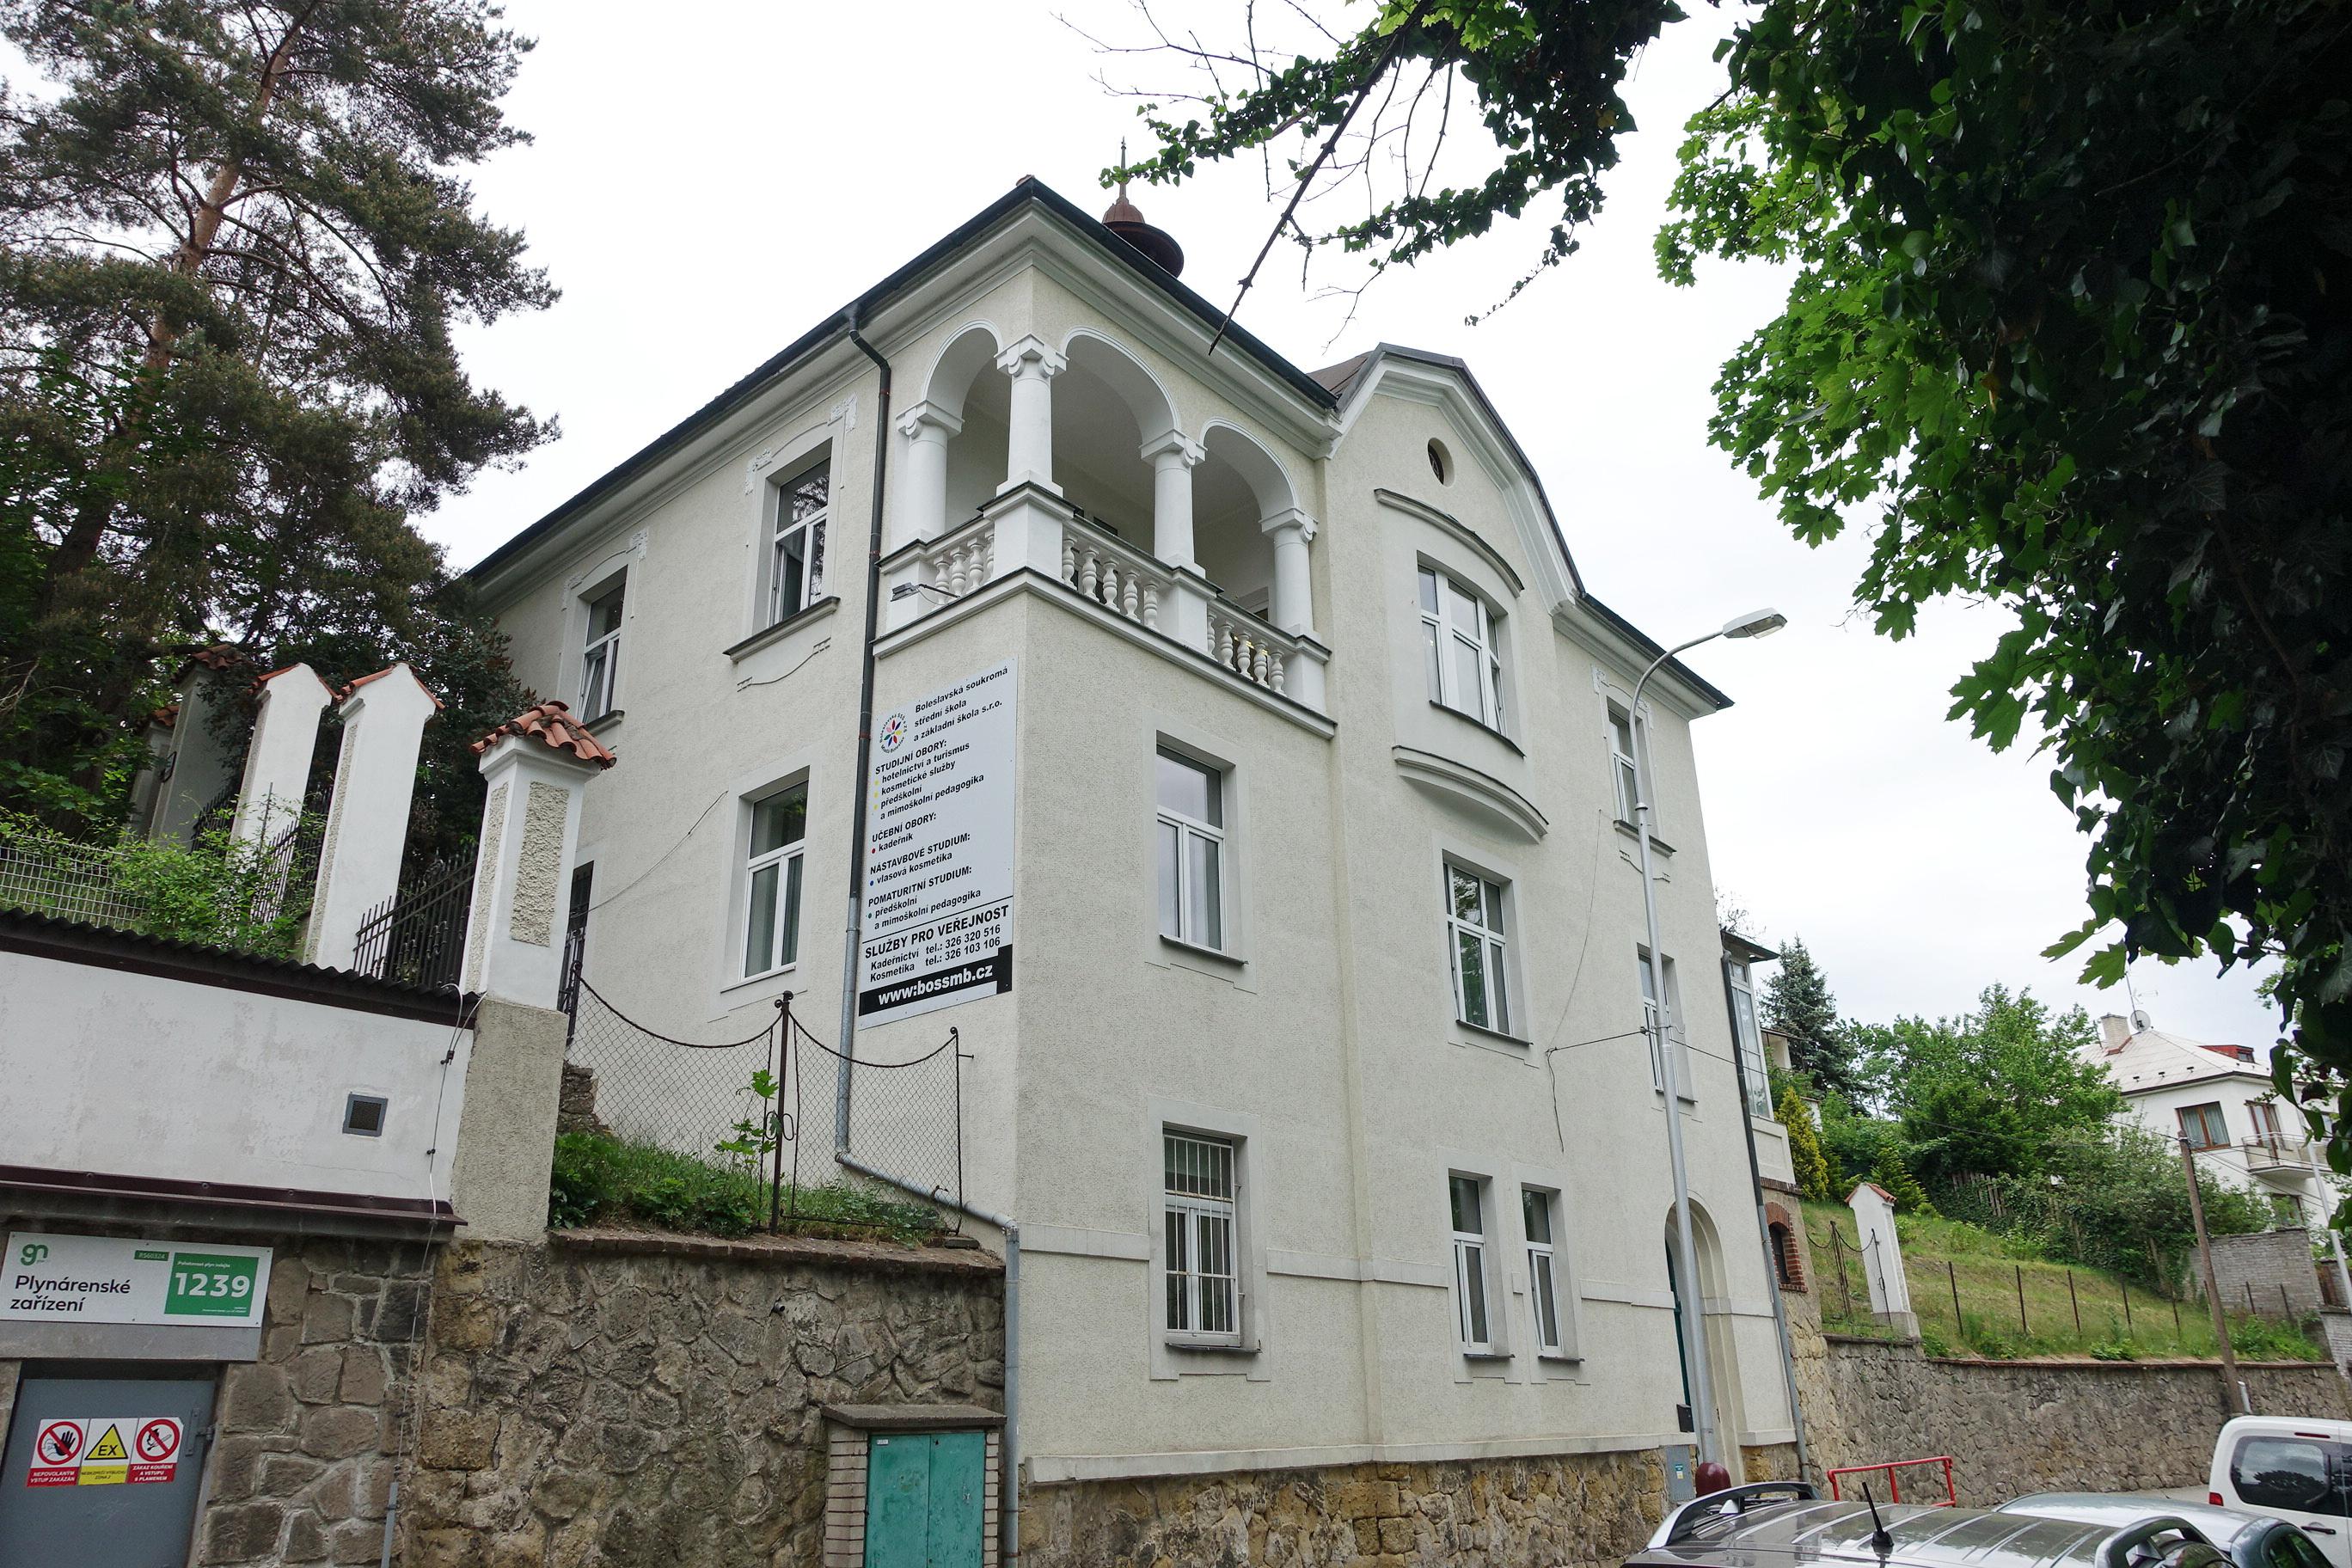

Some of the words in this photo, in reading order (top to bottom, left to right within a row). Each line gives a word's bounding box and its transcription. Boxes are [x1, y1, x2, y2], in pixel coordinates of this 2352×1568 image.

[916, 686, 964, 714] Boleslavská
[965, 666, 1008, 691] soukromá
[915, 708, 943, 727] střední
[945, 700, 967, 714] škola
[921, 717, 955, 738] základní
[957, 708, 979, 724] škola
[982, 700, 1002, 714] s.r.o.
[875, 750, 913, 775] STUDIJNÍ
[916, 739, 947, 758] OBORY:
[882, 759, 924, 783] hotelnictví
[934, 743, 970, 763] turismus
[881, 770, 928, 795] kosmetické
[929, 761, 956, 777] služby
[880, 784, 922, 810] předškolní
[887, 793, 933, 818] mimoškolní
[935, 775, 984, 801] pedagogika
[872, 821, 903, 842] UČEBNÍ
[905, 812, 936, 830] OBORY:
[879, 832, 913, 852] kadeřník
[870, 846, 925, 875] NÁSTAVBOVÉ
[928, 833, 971, 854] STUDIUM:
[877, 866, 907, 884] vlasová
[909, 852, 952, 873] kosmetika
[868, 878, 926, 907] POMATURITNÍ
[928, 866, 972, 887] STUDIUM:
[875, 895, 917, 919] předškolní
[882, 904, 928, 928] mimoškolní
[930, 890, 981, 914] pedagogika
[865, 936, 909, 959] SLUŽBY
[911, 928, 934, 945] PRO
[938, 905, 1009, 936] VEŘEJNOST
[871, 948, 919, 971] Kadeřnictví
[926, 942, 943, 955] tel.:
[945, 935, 962, 949] 326
[965, 930, 981, 943] 320
[983, 924, 1001, 937] 516
[870, 963, 915, 983] Kosmetika
[925, 955, 942, 967] tel.:
[945, 948, 961, 961] 326
[964, 942, 981, 955] 103
[984, 937, 1001, 949] 106
[15, 1275, 131, 1295] Plynárenské
[175, 1272, 250, 1298] 1239
[10, 1295, 84, 1312] zařízení
[98, 1444, 118, 1456] EX
